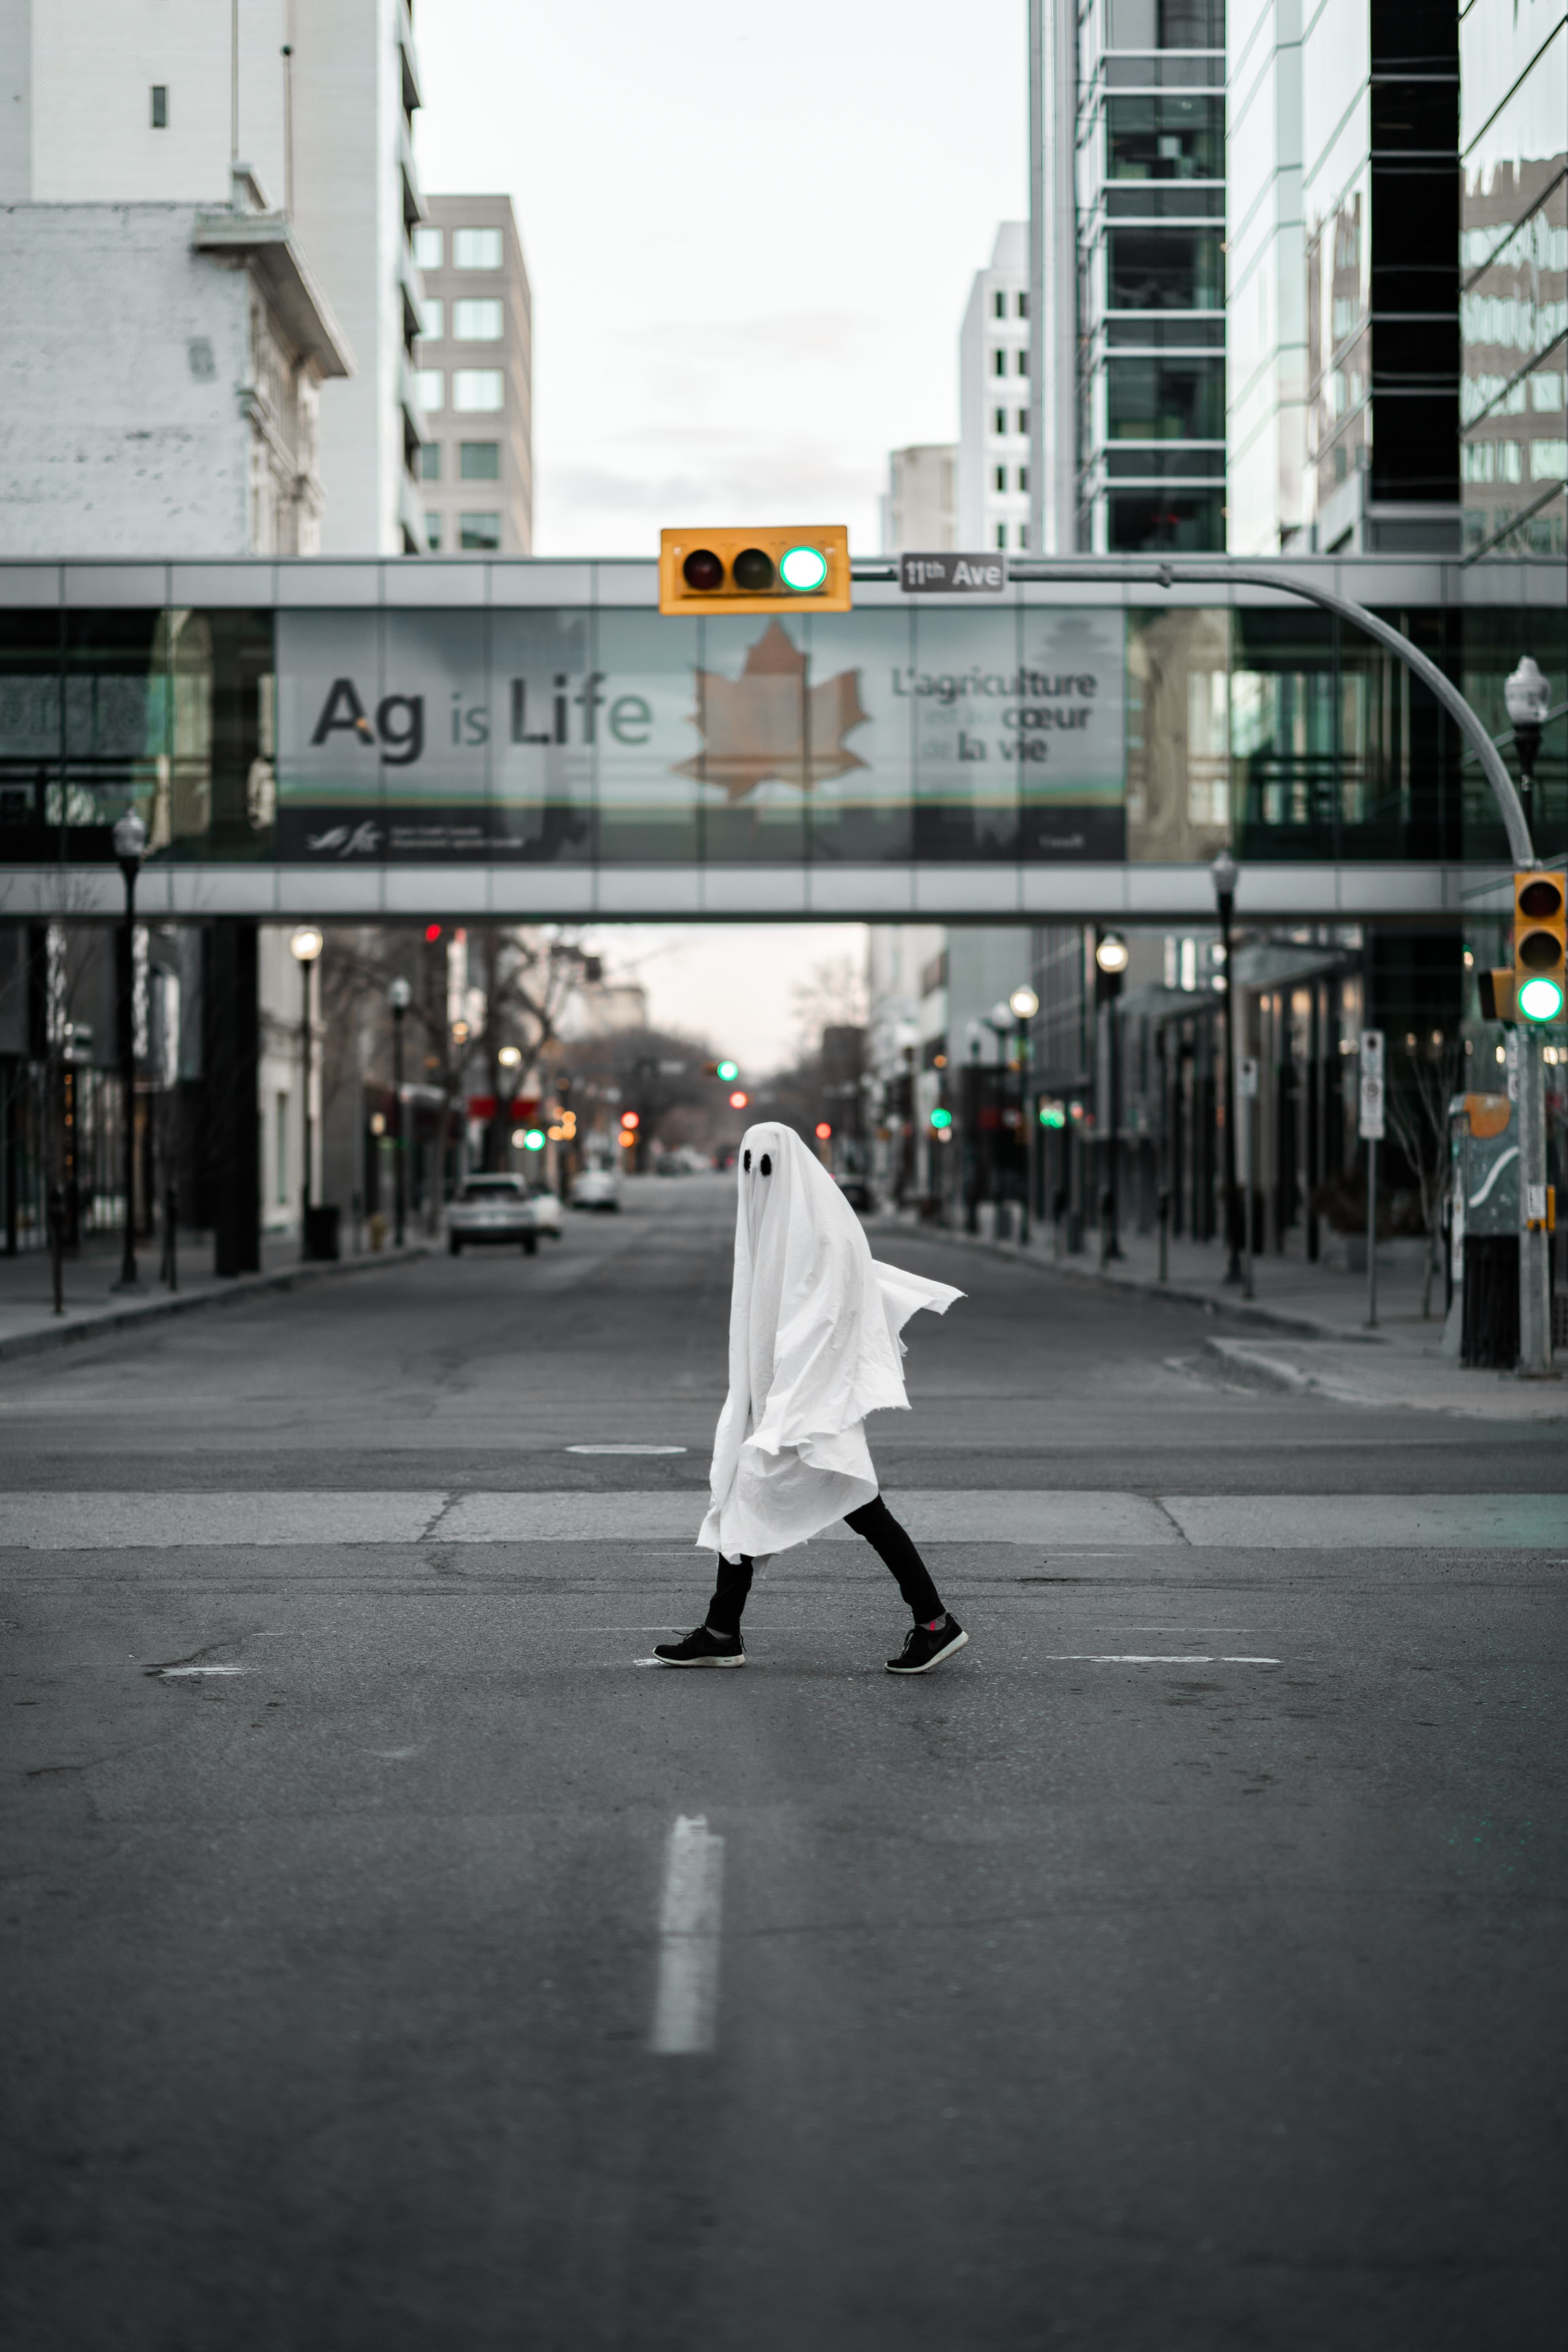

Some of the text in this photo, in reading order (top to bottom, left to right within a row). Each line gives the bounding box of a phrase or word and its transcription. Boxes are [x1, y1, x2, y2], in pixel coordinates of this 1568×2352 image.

[905, 561, 1001, 586] 11th Ave
[892, 667, 1098, 705] L'agriculture
[310, 672, 653, 766] Ag is Life
[958, 731, 986, 761] la
[999, 733, 1048, 762] vie
